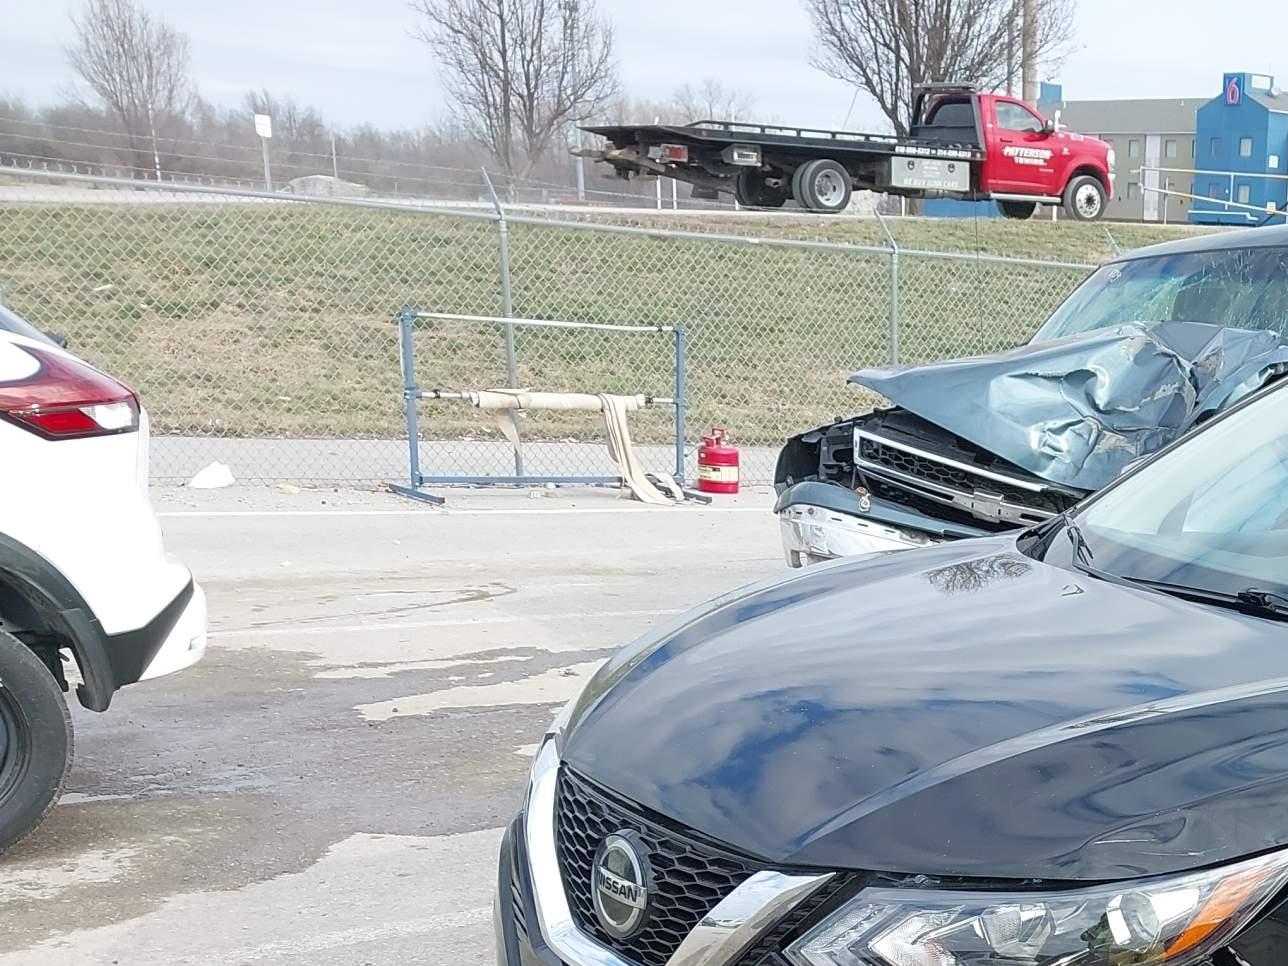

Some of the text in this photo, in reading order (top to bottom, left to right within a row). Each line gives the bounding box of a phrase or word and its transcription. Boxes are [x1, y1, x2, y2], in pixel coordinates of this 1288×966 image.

[1226, 76, 1239, 104] 6
[1003, 145, 1052, 159] PATTERSON
[597, 872, 638, 903] NISSAN
